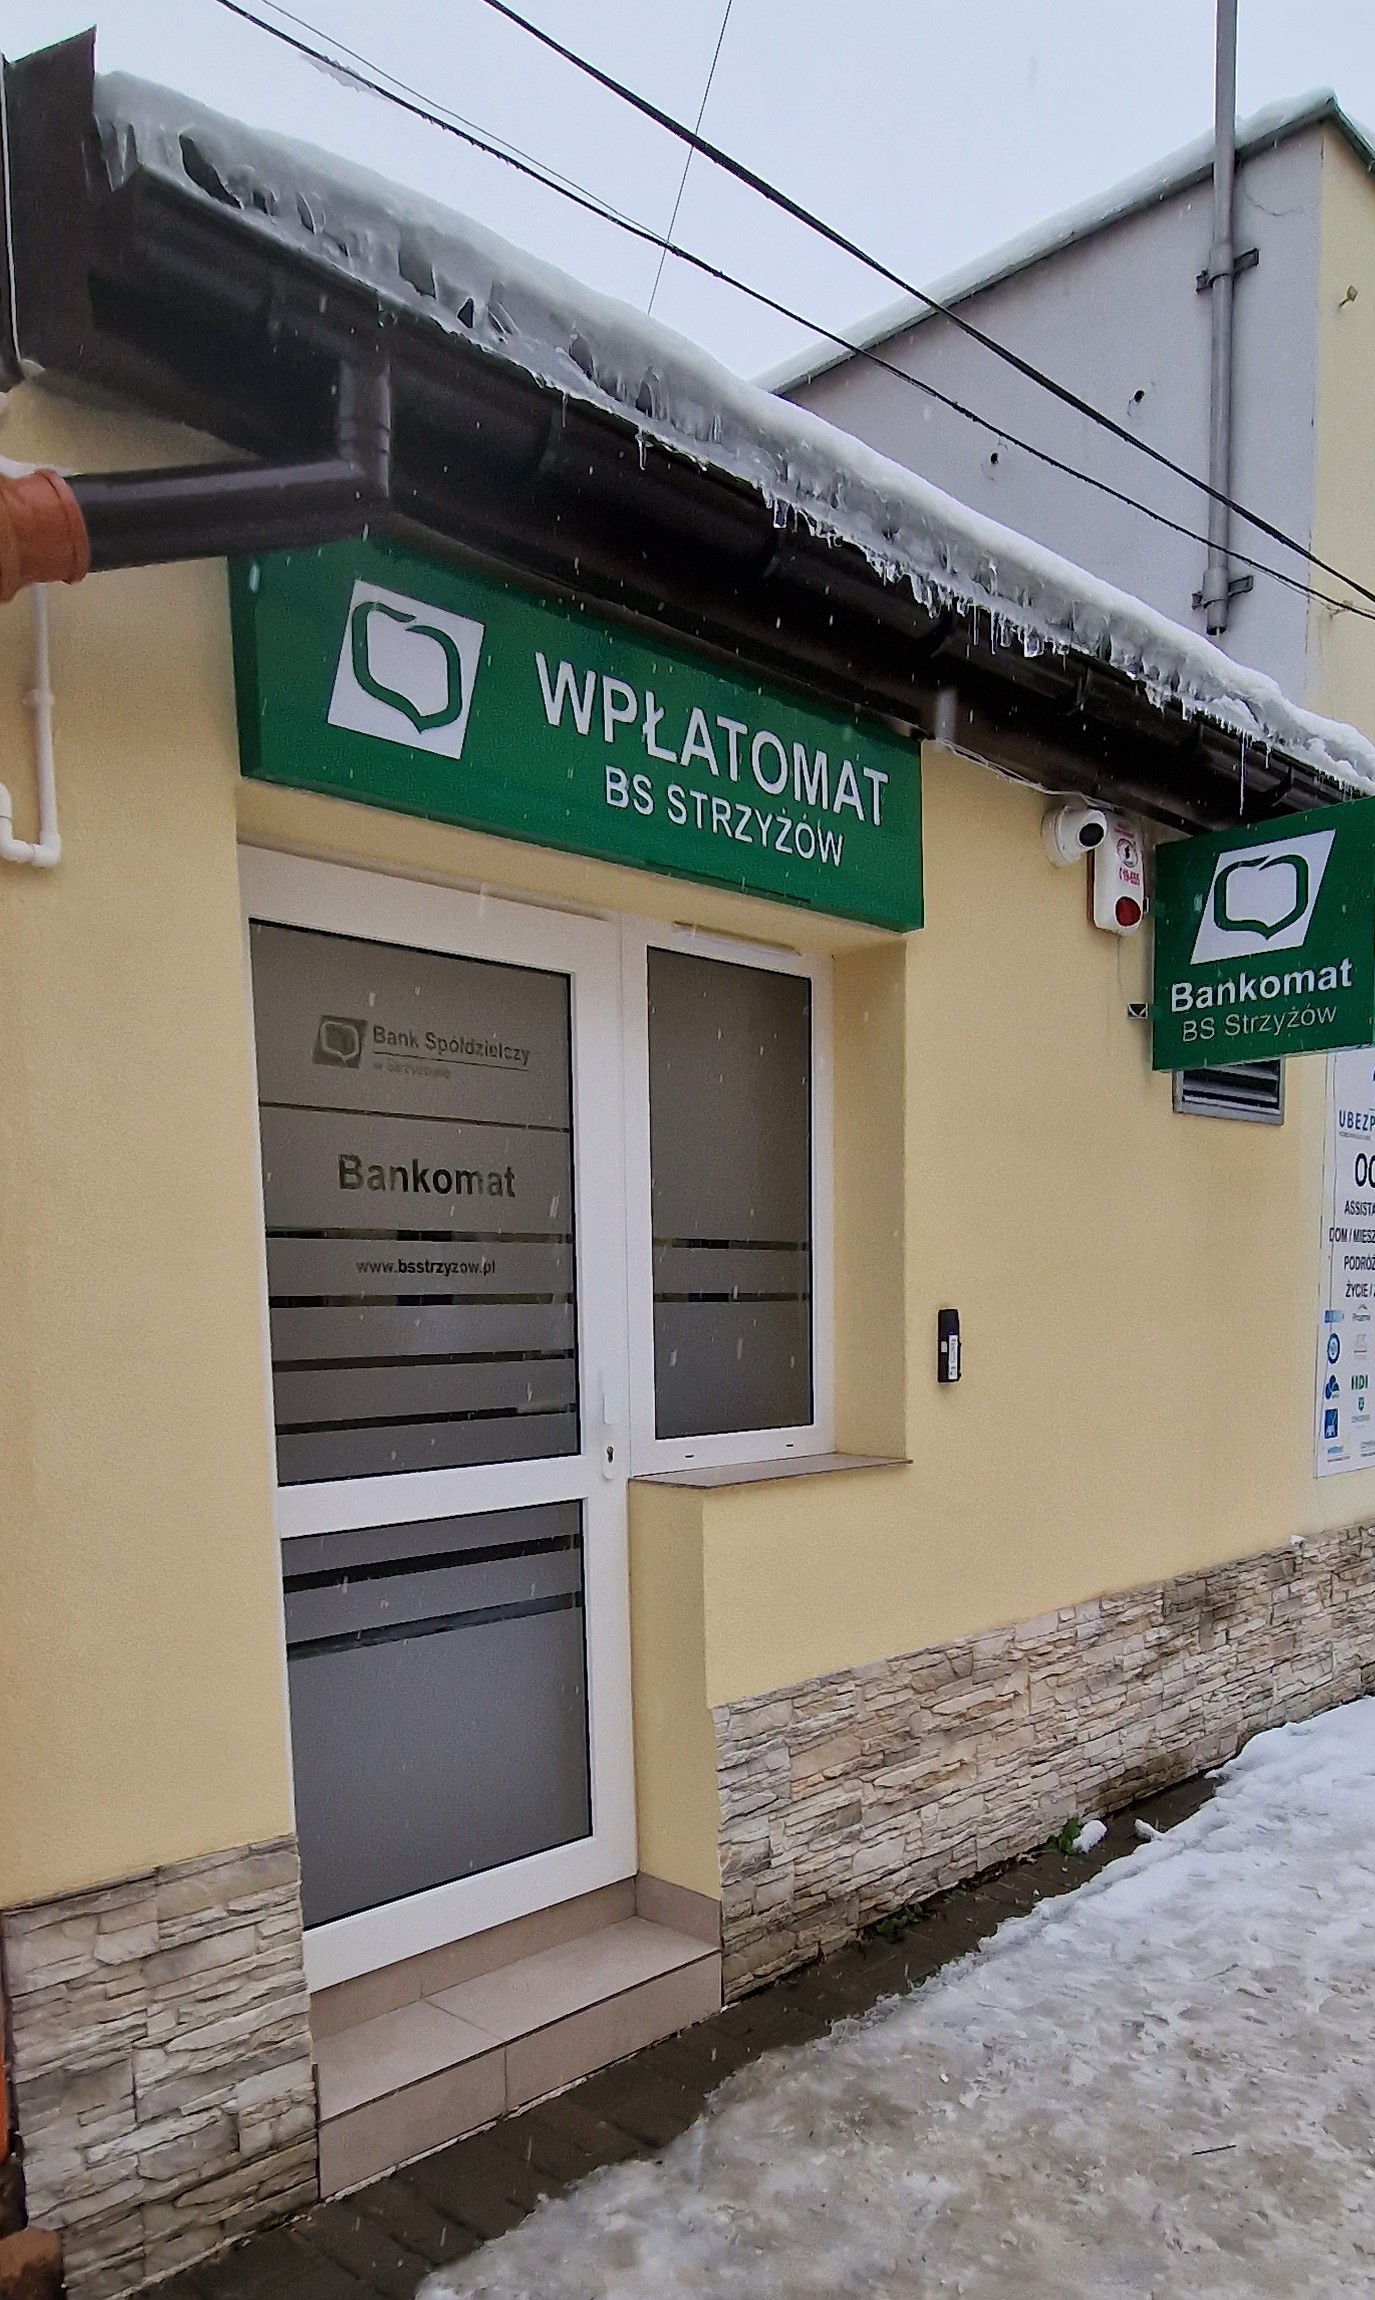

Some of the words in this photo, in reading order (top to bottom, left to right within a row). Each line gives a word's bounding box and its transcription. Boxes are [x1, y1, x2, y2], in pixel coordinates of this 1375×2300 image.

[535, 651, 889, 826] WPŁATOMAT
[605, 765, 654, 816] BS
[667, 783, 844, 867] STRZYŻÓW
[1171, 957, 1353, 1013] Bankomat
[1183, 1016, 1216, 1043] BS
[1225, 1004, 1338, 1036] Strzyżów
[373, 1025, 419, 1048] Bank
[425, 1031, 531, 1065] Spółdzielczy
[1339, 1109, 1375, 1131] UBEZP
[338, 1153, 517, 1198] Bankomat
[1329, 1227, 1348, 1243] DOM
[355, 1258, 497, 1278] www.bsstrzyzow.pl
